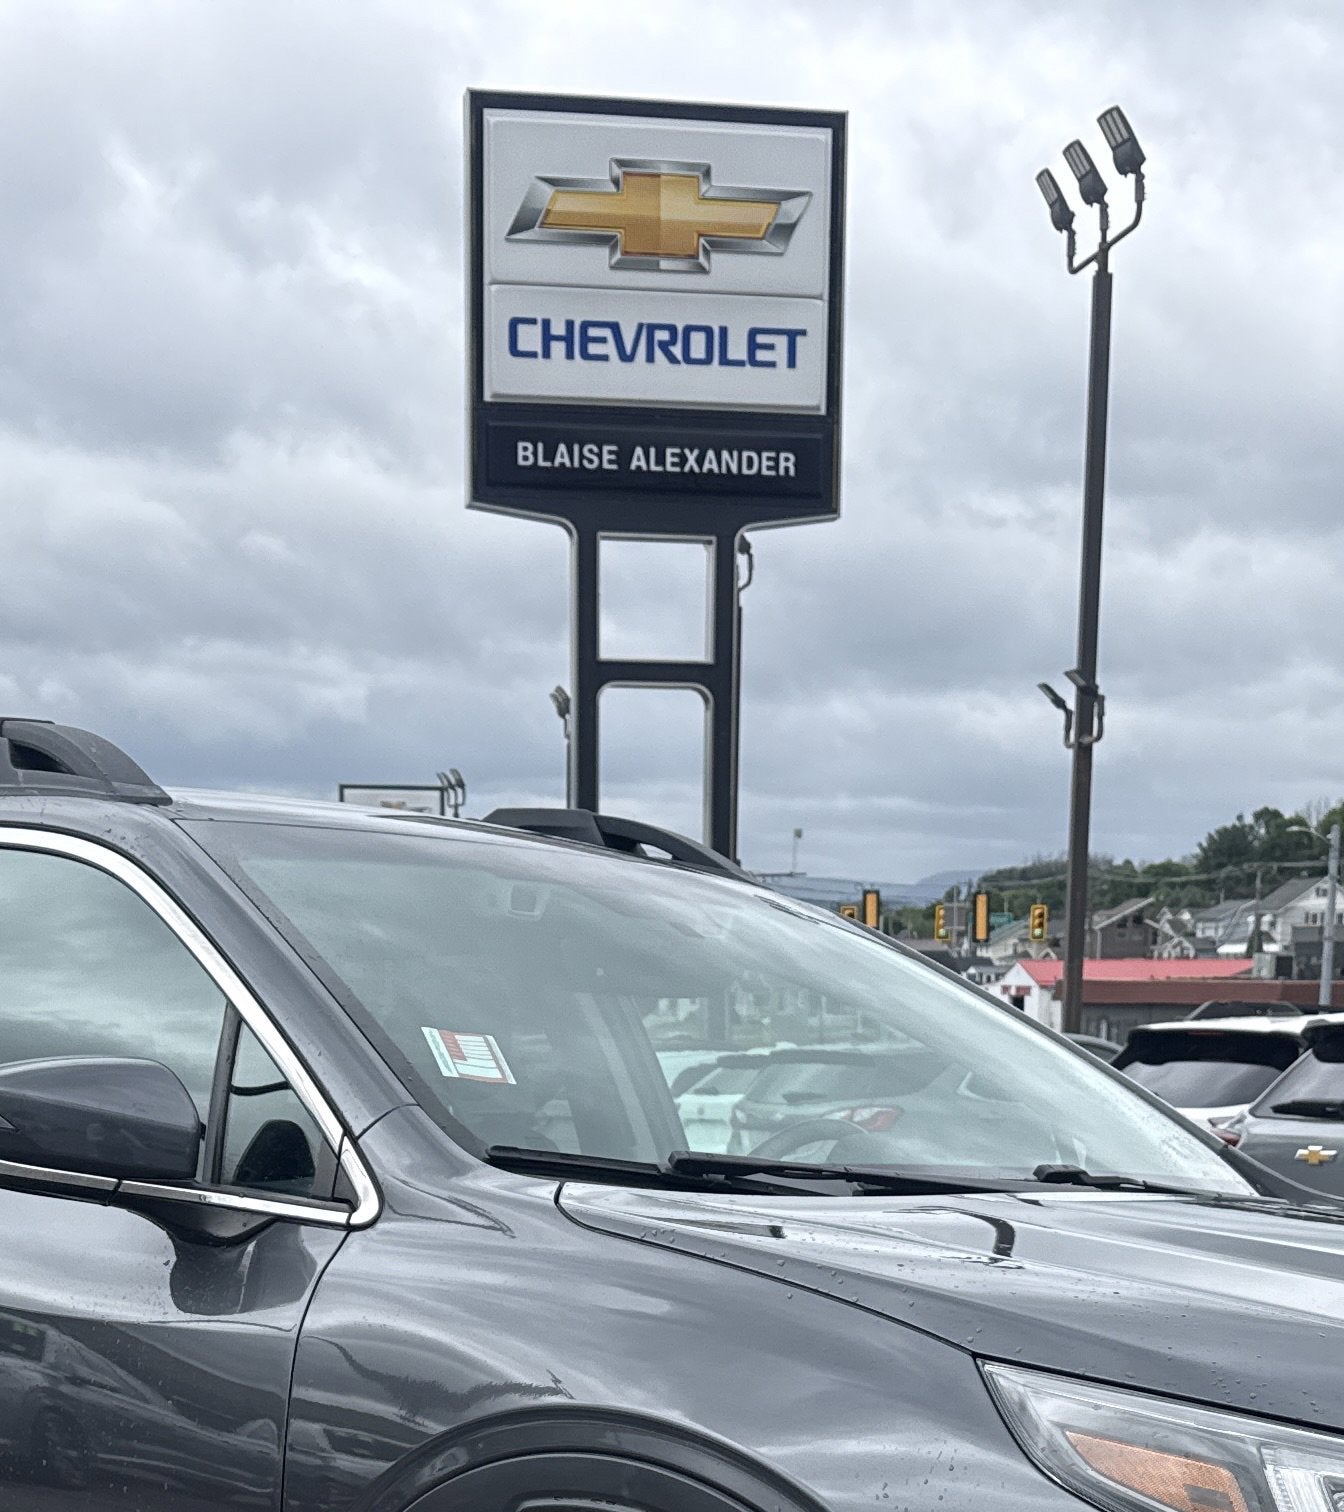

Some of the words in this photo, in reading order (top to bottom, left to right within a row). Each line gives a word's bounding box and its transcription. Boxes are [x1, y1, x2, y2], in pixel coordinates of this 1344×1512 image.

[507, 316, 807, 370] CHEVROLET
[516, 441, 619, 470] BLAISE
[629, 446, 797, 477] ALEXANDER
